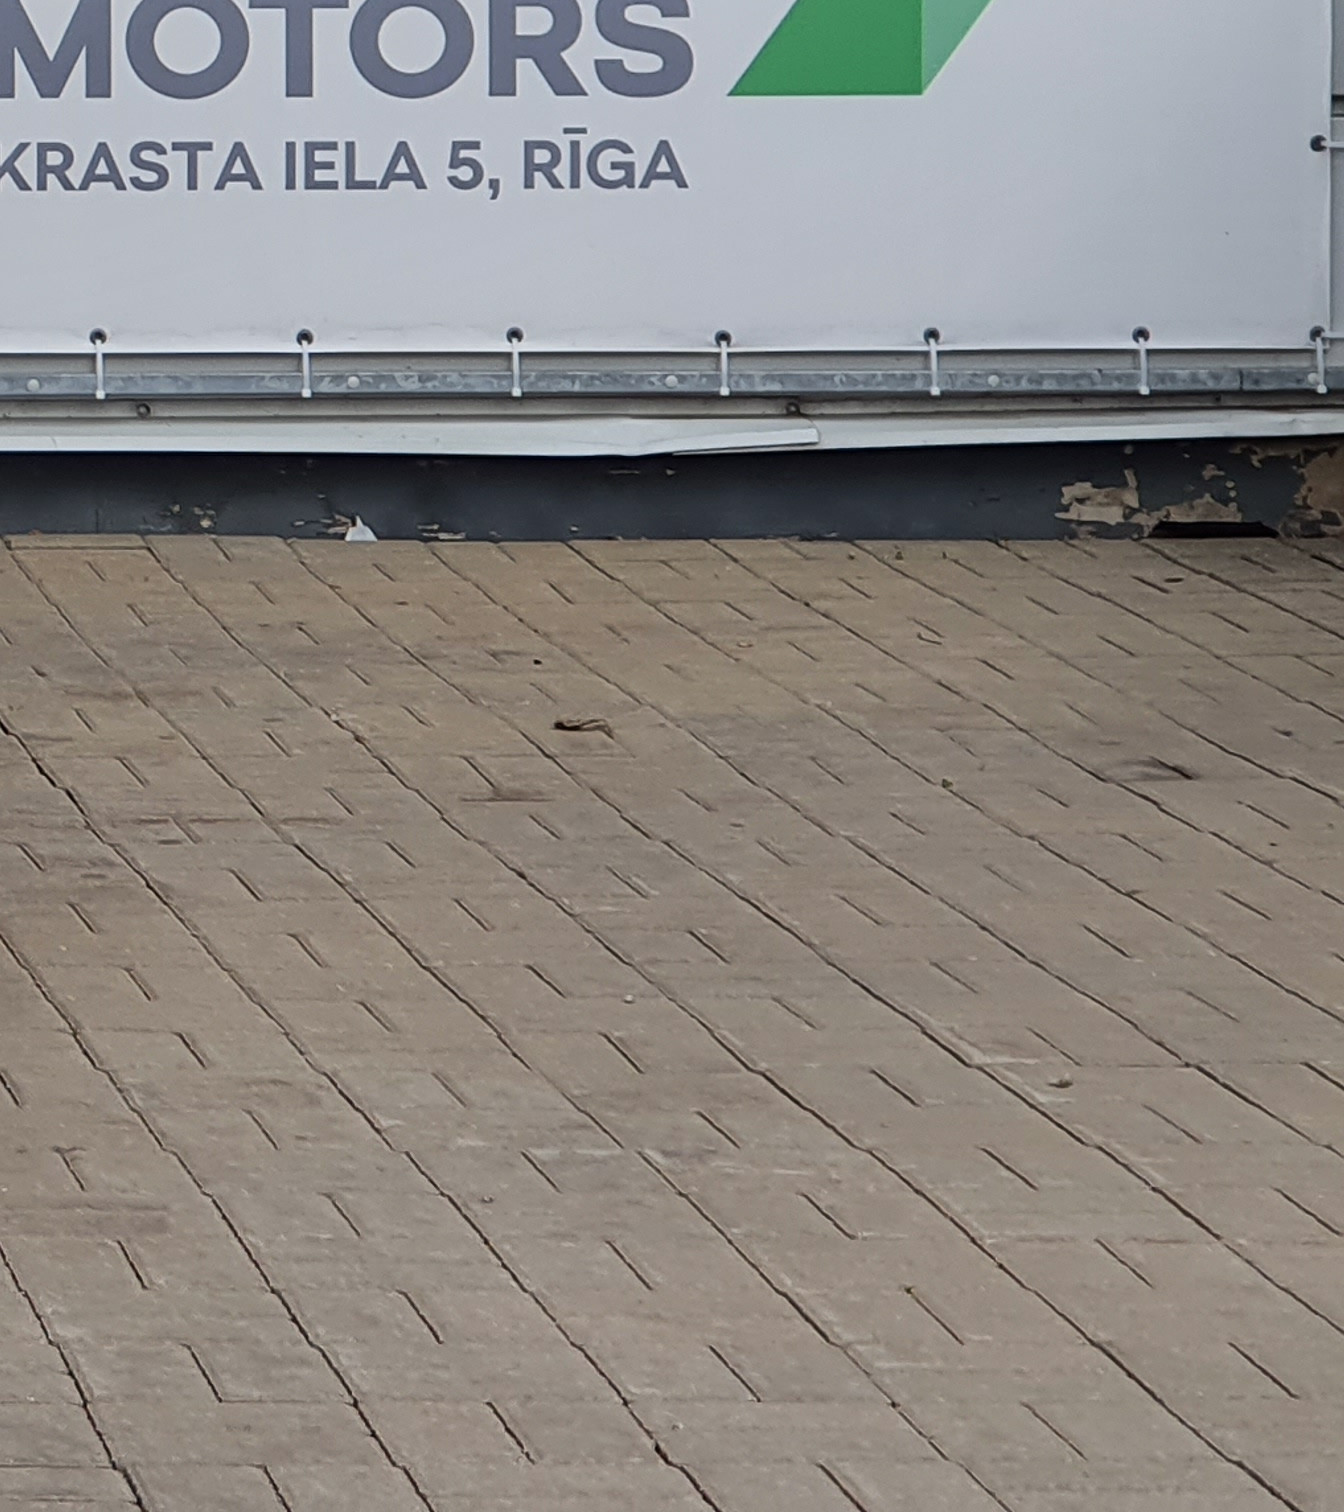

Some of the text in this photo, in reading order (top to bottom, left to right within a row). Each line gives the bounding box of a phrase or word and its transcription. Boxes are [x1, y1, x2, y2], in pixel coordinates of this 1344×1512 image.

[285, 141, 427, 190] IELA
[447, 141, 500, 200] 5,
[524, 128, 688, 189] RĪGA
